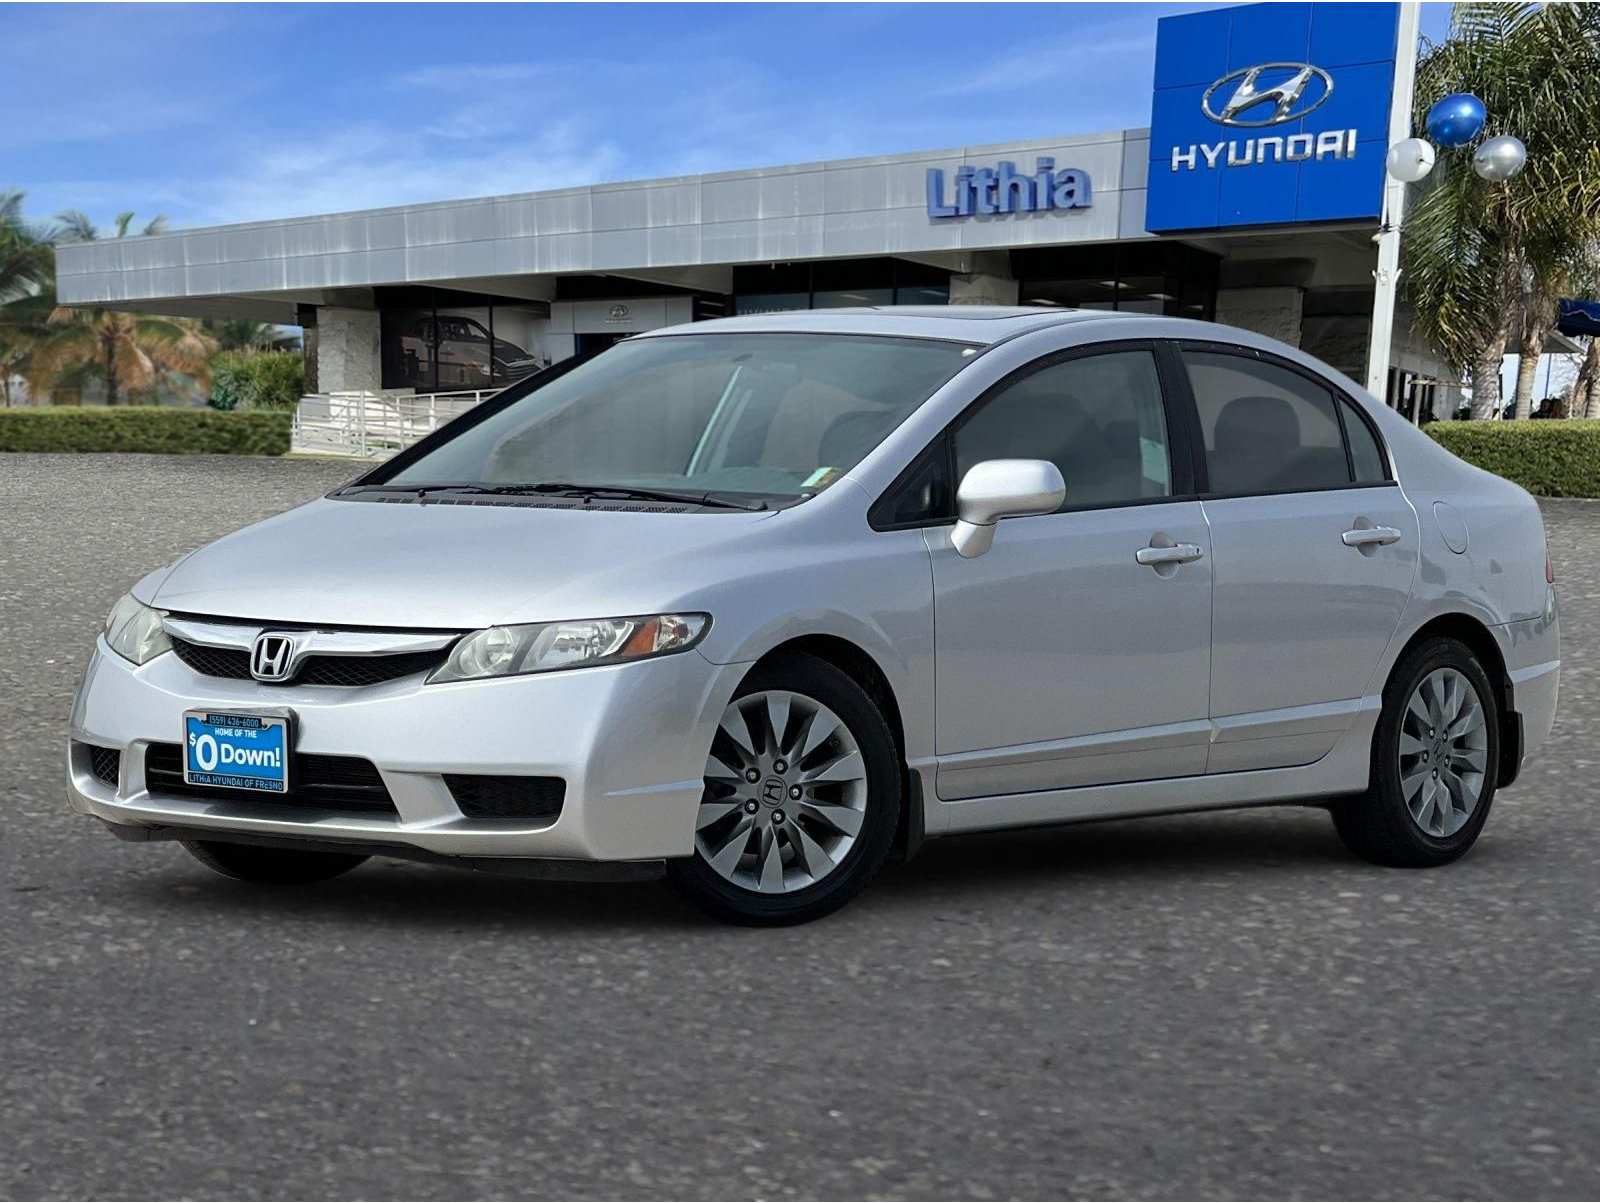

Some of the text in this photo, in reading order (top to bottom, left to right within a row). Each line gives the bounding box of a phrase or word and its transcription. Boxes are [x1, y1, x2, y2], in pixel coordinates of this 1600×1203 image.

[1171, 129, 1357, 171] HYUNDAI
[926, 156, 1092, 217] Lithia
[214, 727, 257, 739] HOME OF THE
[220, 743, 281, 768] Down!
[188, 773, 211, 784] LITHIA
[212, 776, 243, 787] HYUNDAI
[244, 779, 254, 788] OF
